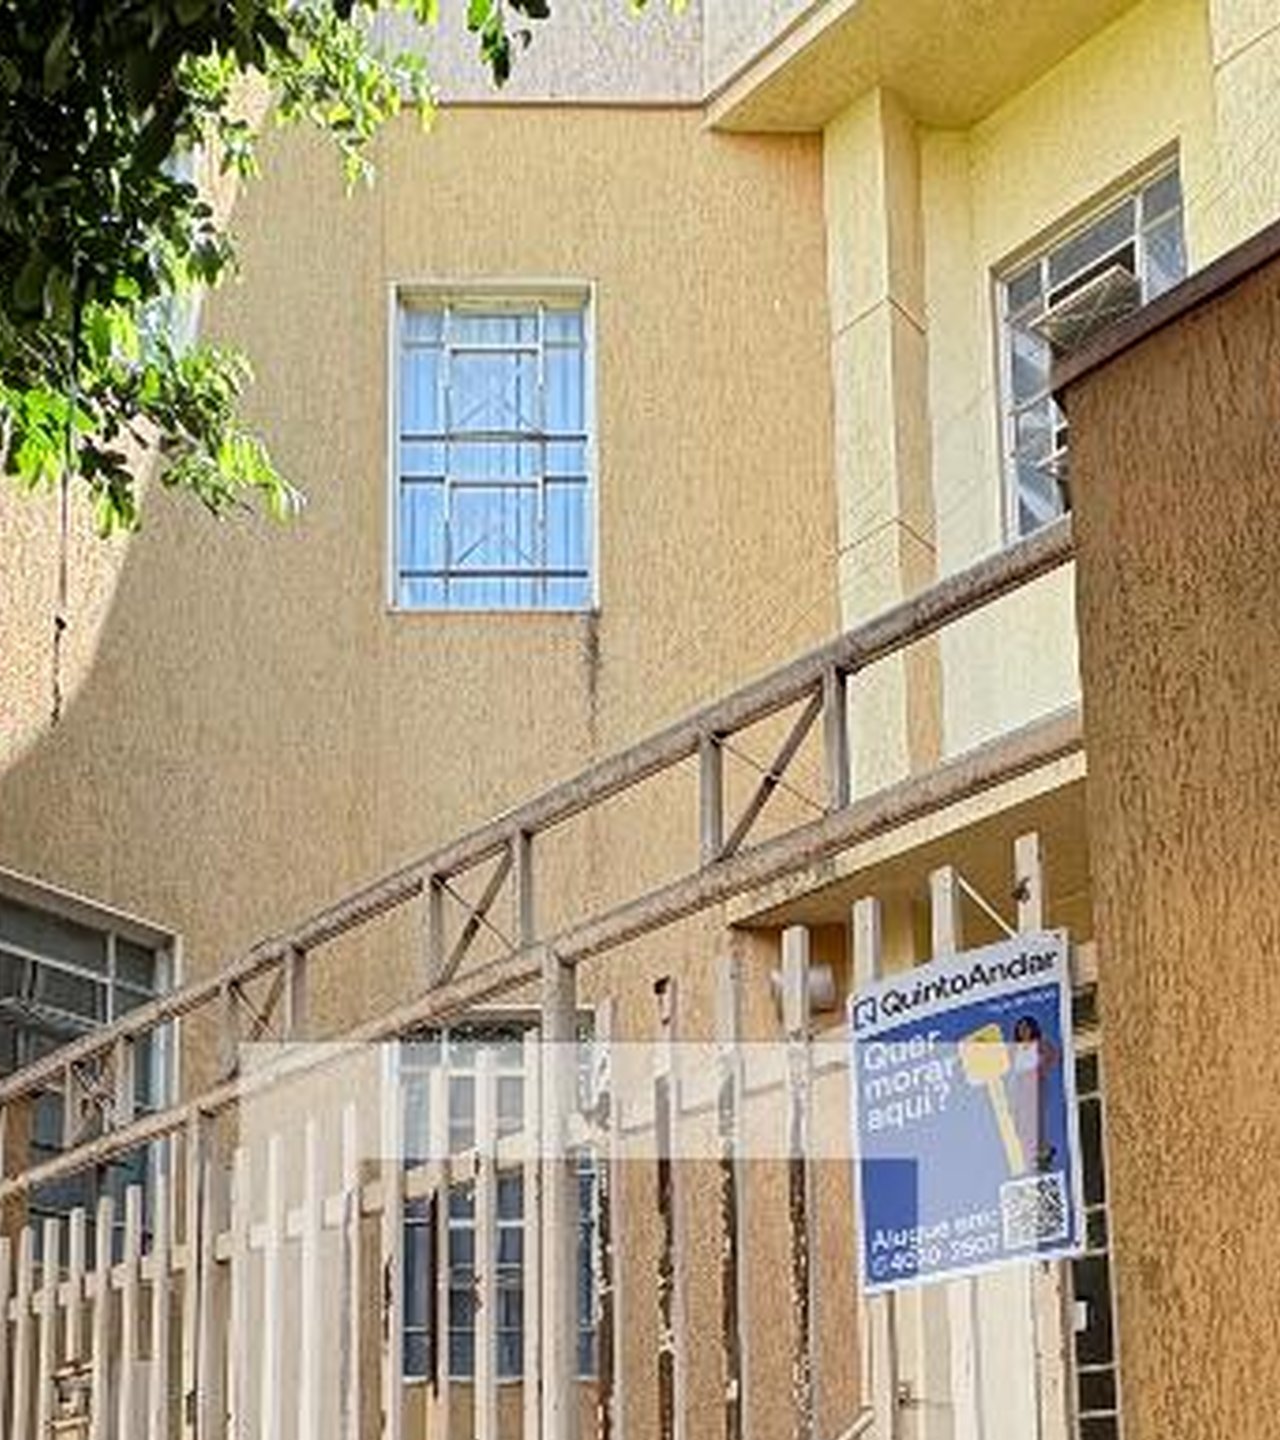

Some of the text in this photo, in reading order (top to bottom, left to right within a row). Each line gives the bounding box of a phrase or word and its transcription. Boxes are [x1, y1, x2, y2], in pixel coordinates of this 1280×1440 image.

[879, 950, 1058, 1018] QuintoAndar
[864, 1028, 941, 1070] Quer
[864, 1054, 954, 1101] morar
[867, 1080, 950, 1130] aqui?
